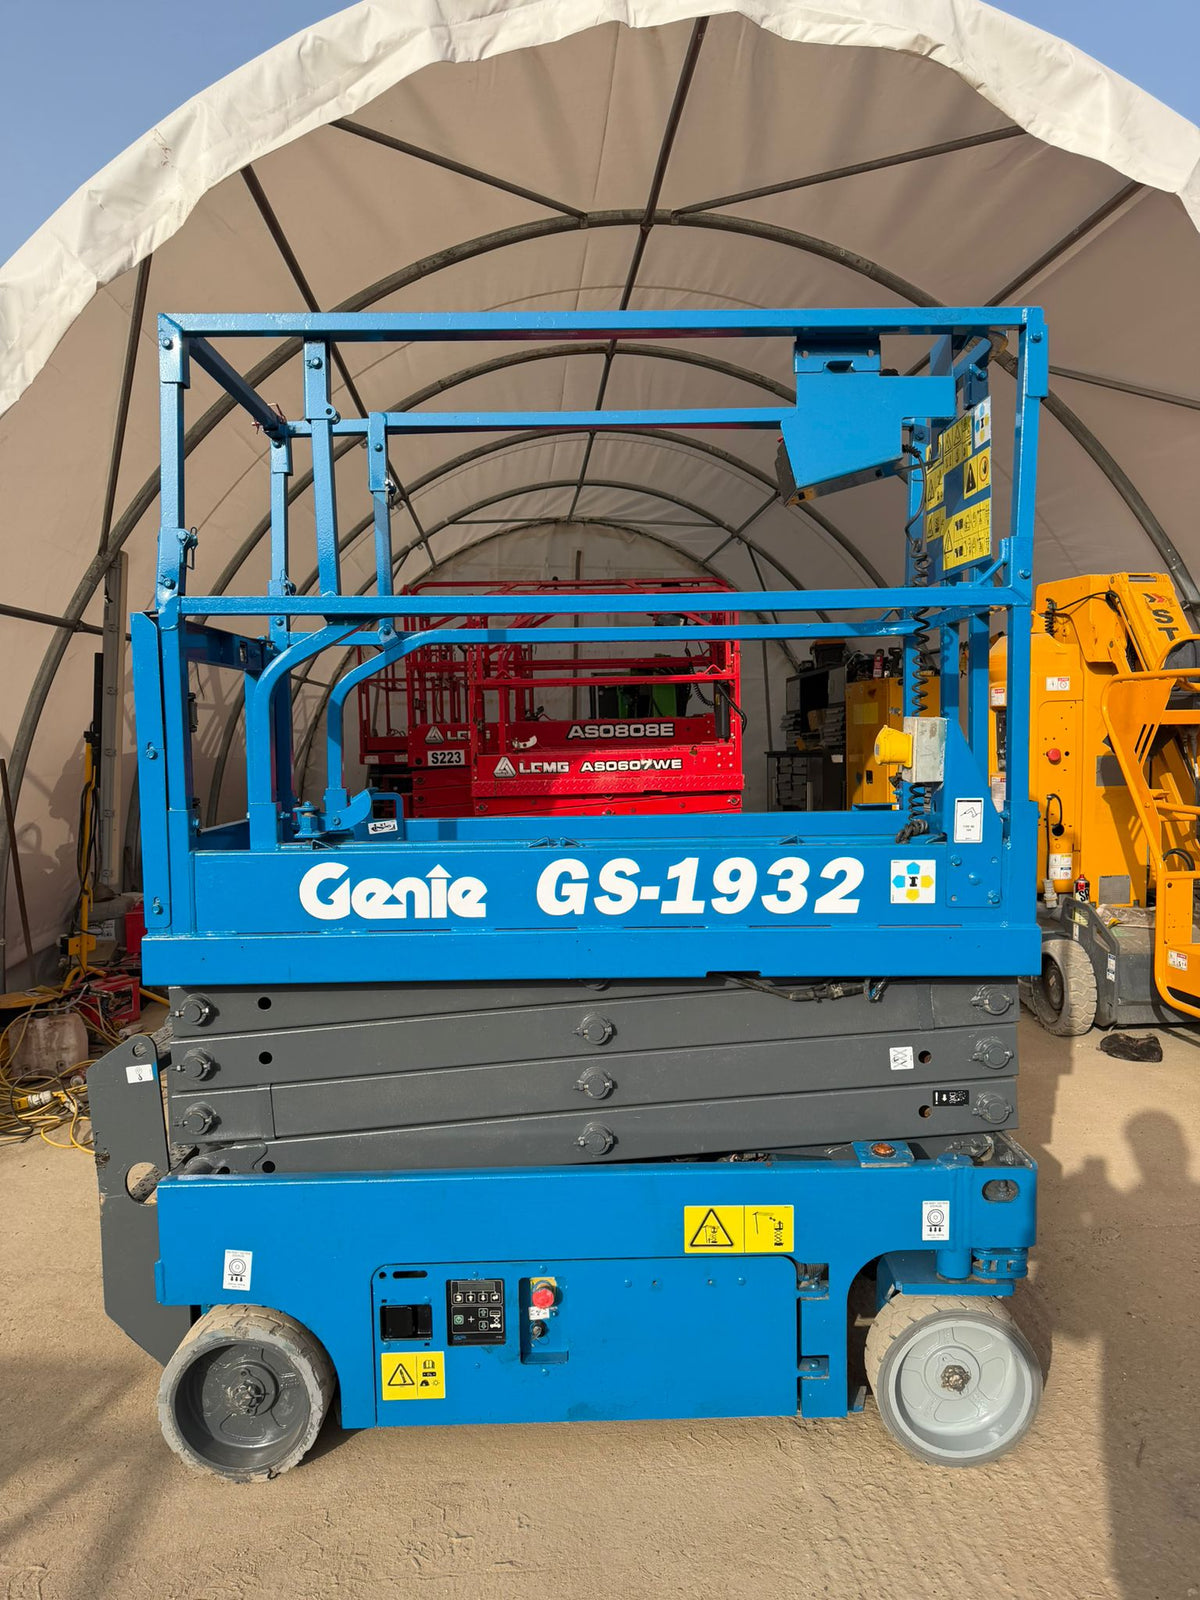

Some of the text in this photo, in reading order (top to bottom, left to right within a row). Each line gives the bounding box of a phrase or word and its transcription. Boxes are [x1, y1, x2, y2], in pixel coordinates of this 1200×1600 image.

[431, 751, 462, 765] S223
[298, 856, 865, 921] Genie GS-1932
